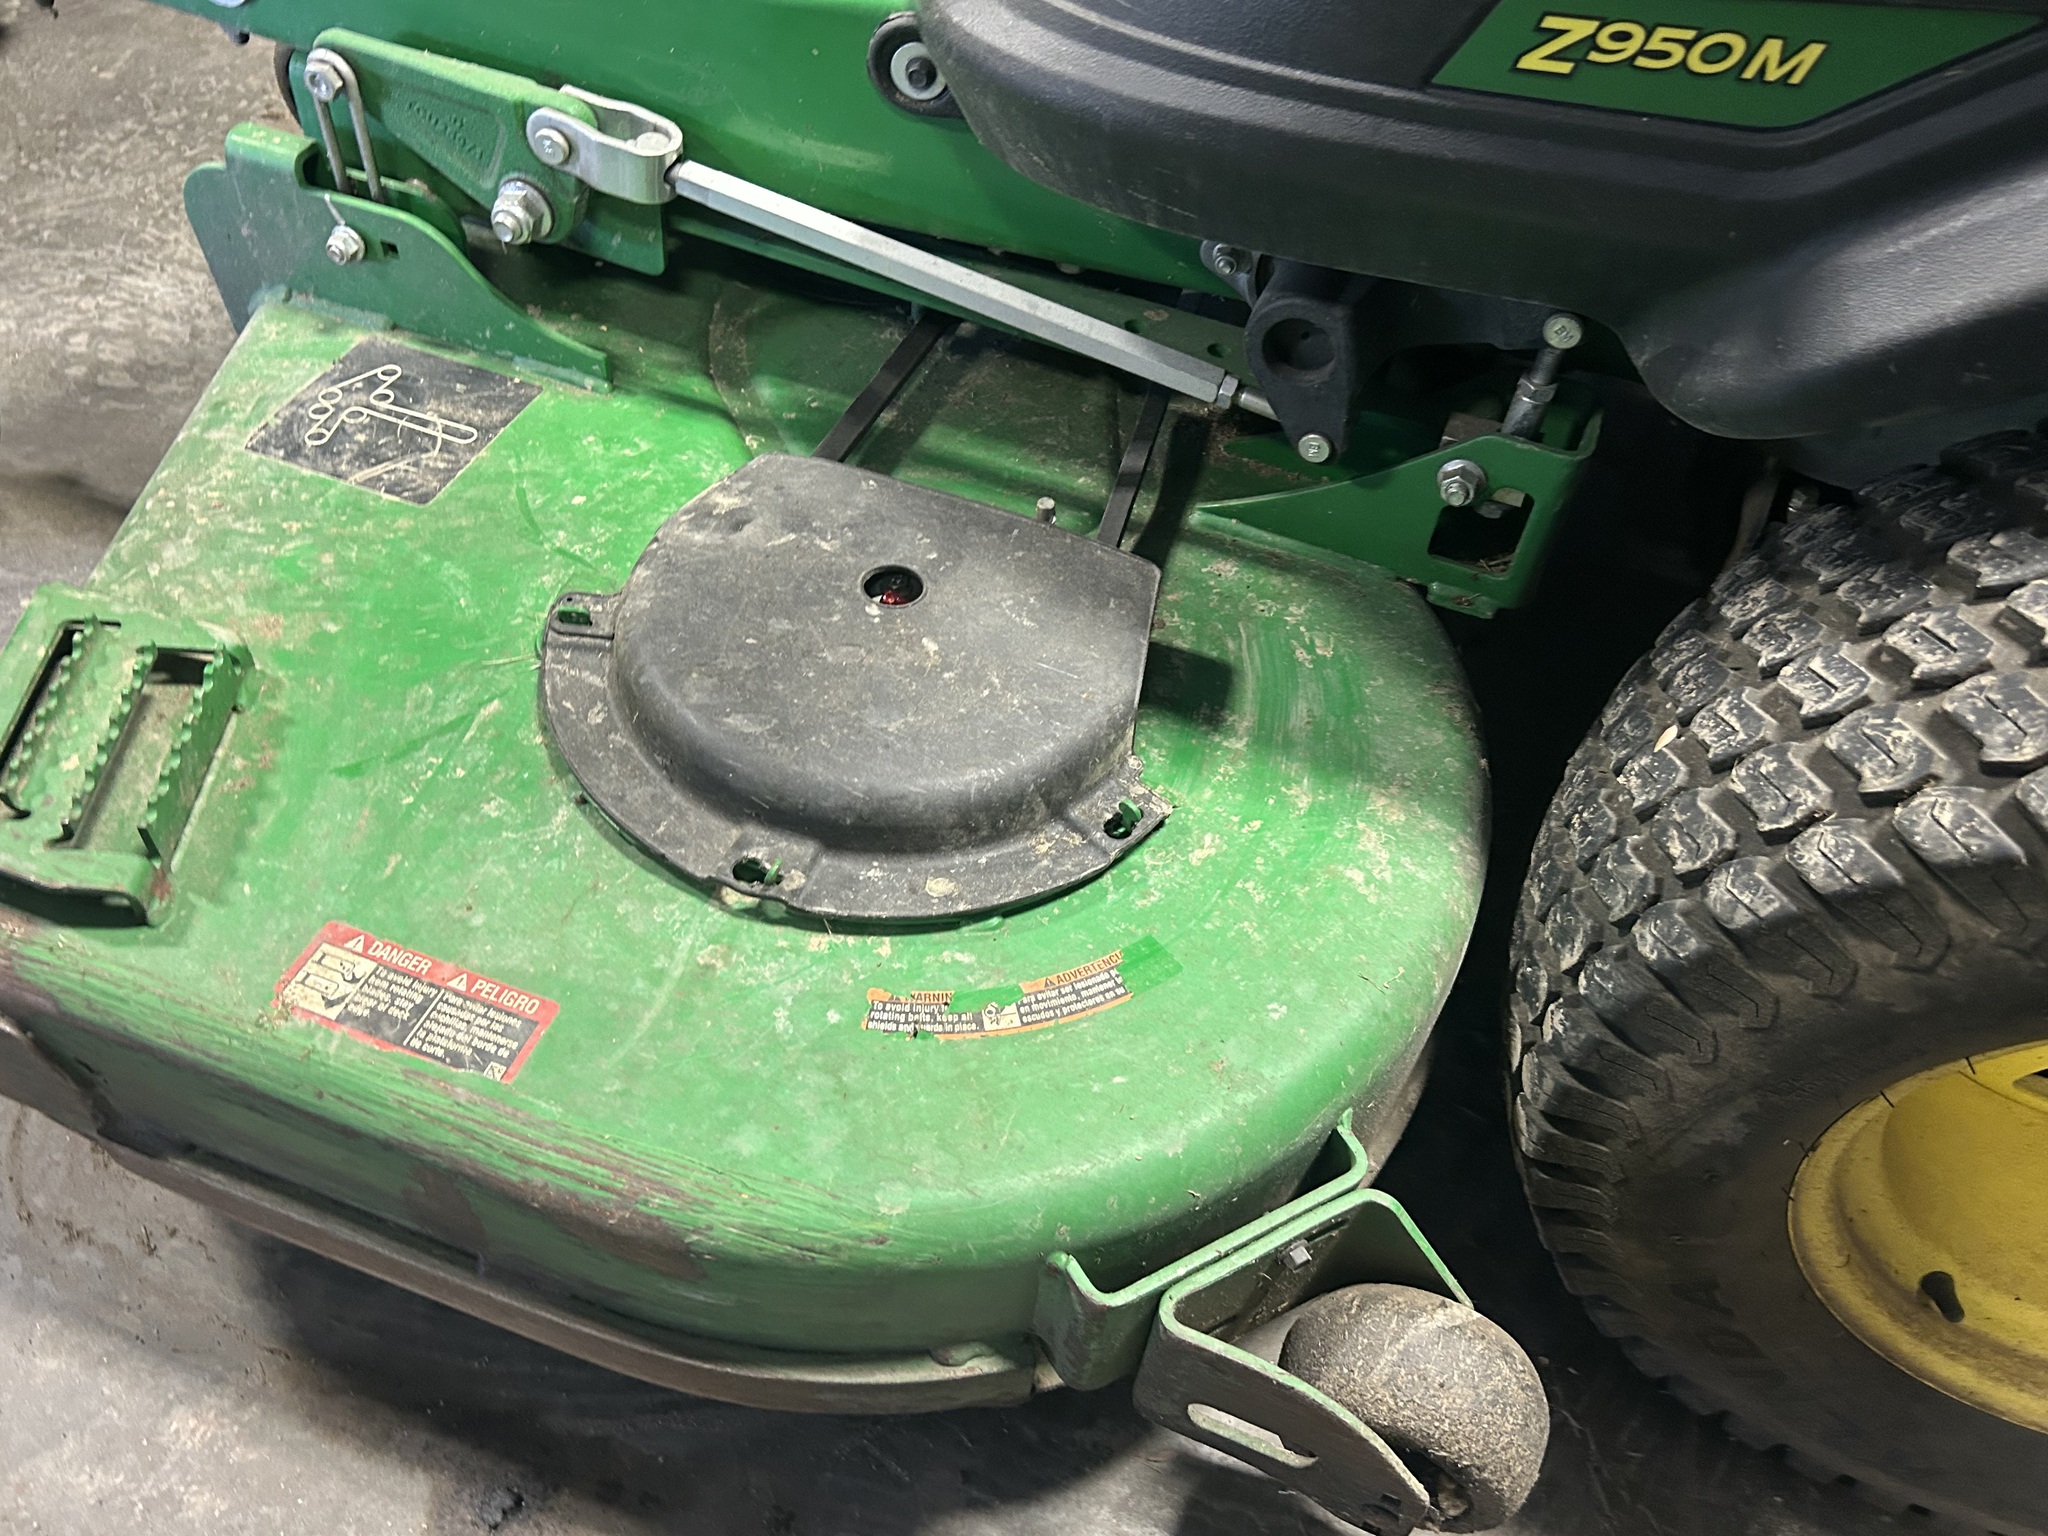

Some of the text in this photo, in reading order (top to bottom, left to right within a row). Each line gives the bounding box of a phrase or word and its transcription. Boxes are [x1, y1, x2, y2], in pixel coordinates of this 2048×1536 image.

[1515, 15, 1828, 85] Z950M
[367, 940, 432, 975] DANGER
[1056, 951, 1122, 985] ADVERTENCI
[376, 965, 387, 978] To
[387, 973, 413, 987] avoid
[390, 983, 424, 1004] rotating
[469, 979, 540, 1016] PELIGRO
[911, 992, 953, 1002] ARNIN
[1018, 995, 1036, 1005] ara
[1037, 989, 1059, 1000] evitar
[1060, 985, 1073, 994] ser
[1073, 971, 1110, 991] lesionado
[1020, 1006, 1030, 1014] en
[1081, 980, 1116, 999] mantener
[394, 997, 414, 1012] stay
[873, 1001, 883, 1010] To
[885, 1003, 910, 1012] avoid
[913, 1004, 939, 1015] injury
[1022, 1010, 1054, 1023] escudos
[1055, 1009, 1060, 1017] y
[1062, 996, 1105, 1016] protectores
[1105, 991, 1116, 999] en
[474, 1016, 491, 1028] por
[490, 1020, 504, 1033] las
[487, 1007, 522, 1028] lesiones
[867, 1021, 897, 1031] shields
[898, 1022, 915, 1033] and
[945, 1023, 952, 1032] in
[954, 1023, 979, 1033] place.
[870, 1011, 905, 1022] rotating
[936, 1013, 958, 1022] keep
[961, 1012, 973, 1021] all
[410, 1037, 422, 1049] de
[472, 1037, 497, 1054] borde
[497, 1047, 510, 1058] de
